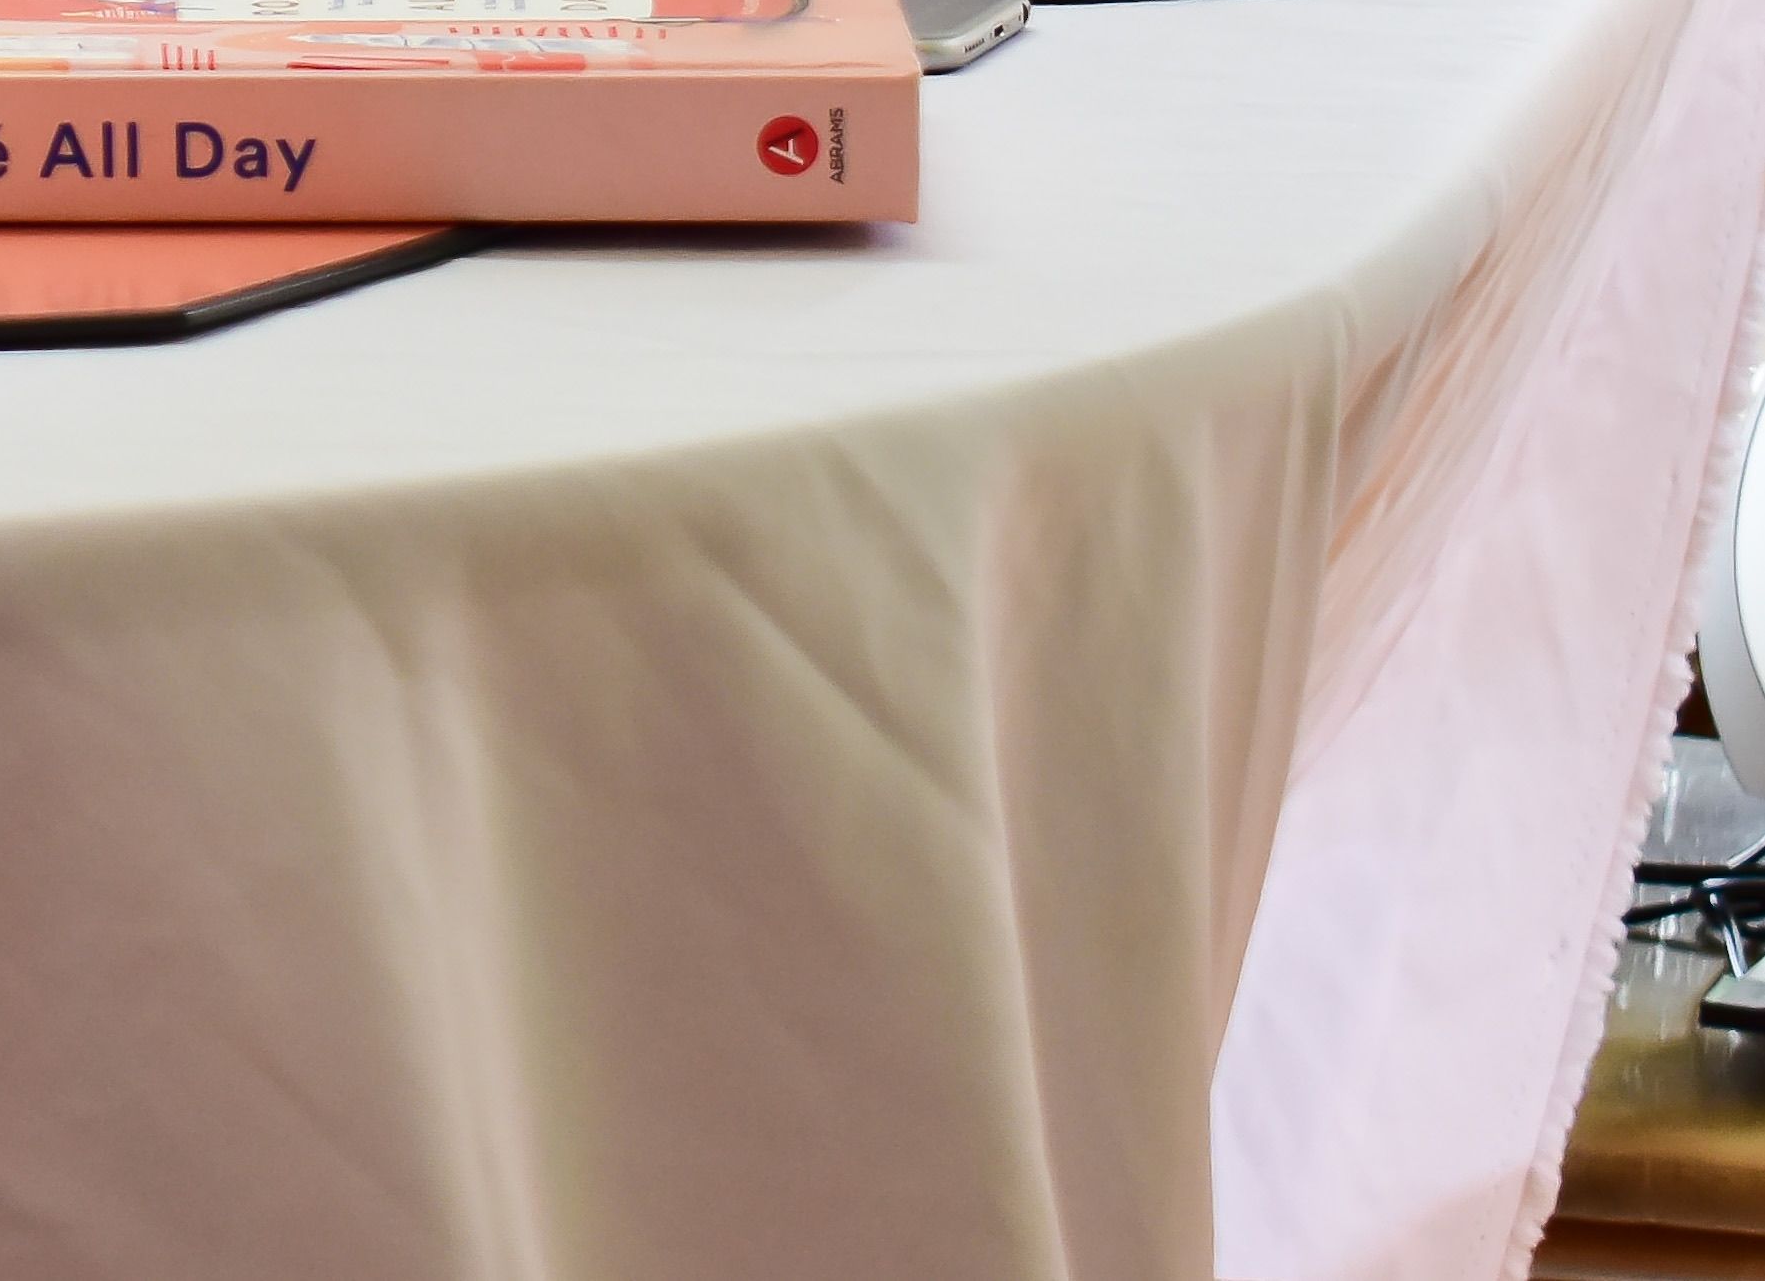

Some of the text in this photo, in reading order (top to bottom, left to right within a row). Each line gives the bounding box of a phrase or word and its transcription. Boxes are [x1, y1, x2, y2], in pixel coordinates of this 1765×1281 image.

[40, 121, 140, 180] All
[175, 121, 317, 193] Day
[829, 107, 845, 184] ABRAMS
